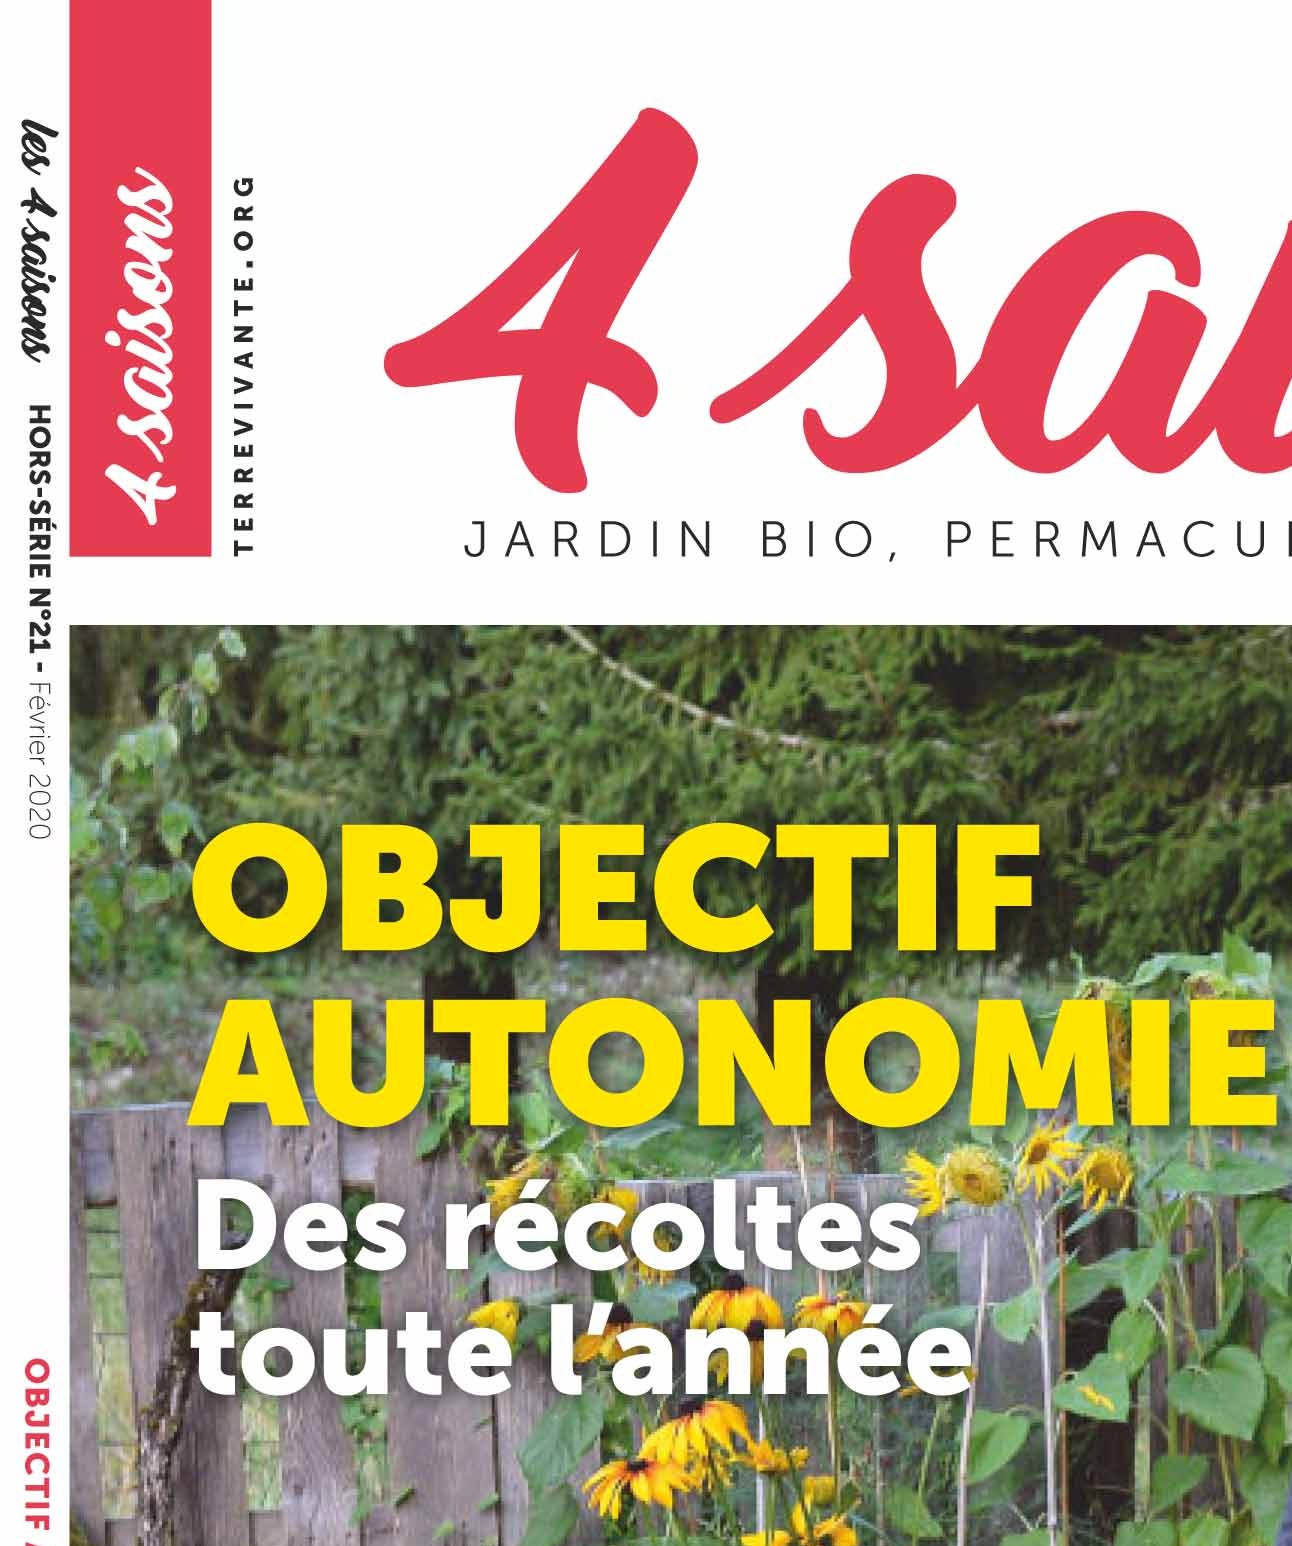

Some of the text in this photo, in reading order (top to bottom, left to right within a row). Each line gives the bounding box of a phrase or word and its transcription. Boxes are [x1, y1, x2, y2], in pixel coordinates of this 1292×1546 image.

[20, 119, 59, 364] les 4 saisons
[384, 108, 698, 493] 4
[105, 168, 176, 524] 4 saisons
[234, 178, 253, 557] TERREVIVANTE.ORG
[29, 405, 57, 578] HORS-SÉRIE
[464, 521, 709, 557] JARDIN
[763, 521, 895, 562] BIO,
[29, 683, 50, 765] Février
[29, 774, 51, 839] 2020
[193, 823, 1039, 952] OBJECTIF
[187, 998, 1276, 1127] AUTONOMIE
[198, 1179, 921, 1270] Des récoltes
[191, 1312, 512, 1396] toute
[25, 1359, 50, 1530] OBJECTIF
